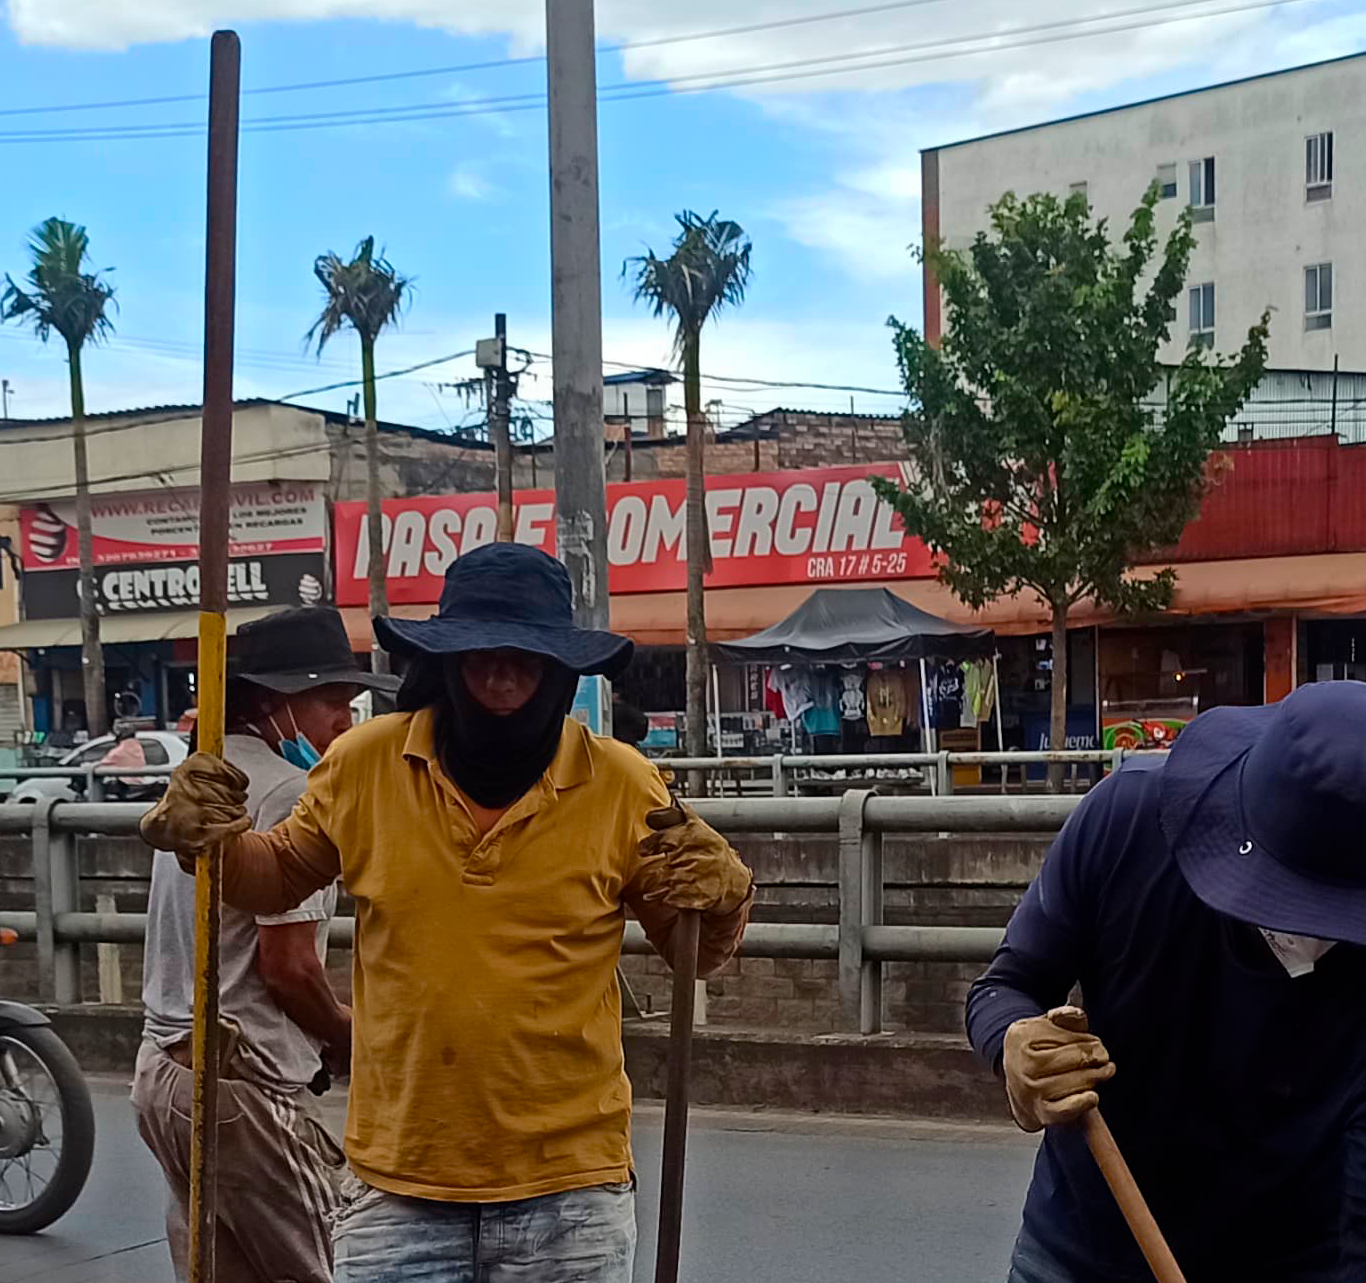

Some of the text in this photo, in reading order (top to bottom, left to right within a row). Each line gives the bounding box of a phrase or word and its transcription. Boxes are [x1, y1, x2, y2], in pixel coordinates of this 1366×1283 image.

[353, 478, 906, 579] PASAE OMERCIAL
[102, 561, 267, 602] CENTROELL
[806, 551, 908, 578] CRA 17 # 5-25
